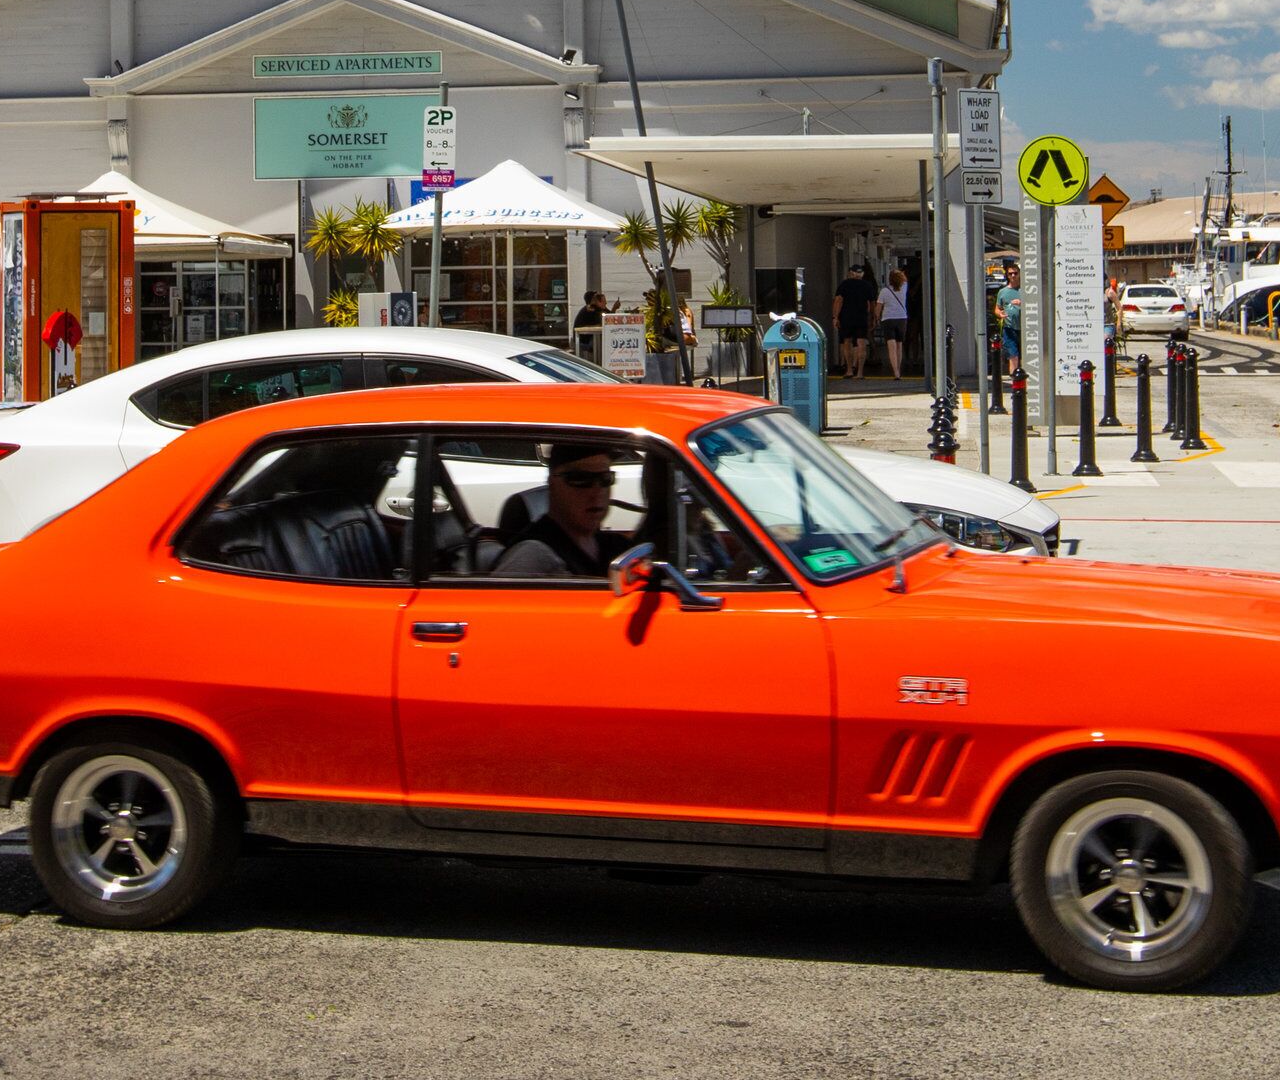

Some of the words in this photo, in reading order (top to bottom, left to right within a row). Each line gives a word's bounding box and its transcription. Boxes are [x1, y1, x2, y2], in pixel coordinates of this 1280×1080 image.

[261, 59, 330, 72] SERVICED
[335, 56, 432, 70] APARTMENTS
[967, 97, 992, 107] WHARF
[427, 110, 453, 126] 2P
[970, 110, 989, 120] LOAD
[971, 123, 989, 132] LIMIT
[308, 132, 388, 146] SOMERSET
[432, 175, 452, 183] 6957
[983, 177, 998, 186] GVM
[1104, 228, 1114, 241] 5
[1024, 218, 1039, 294] STREET
[612, 338, 639, 349] OPEN
[1025, 303, 1040, 417] ELIZABETH
[899, 676, 969, 690] GTR
